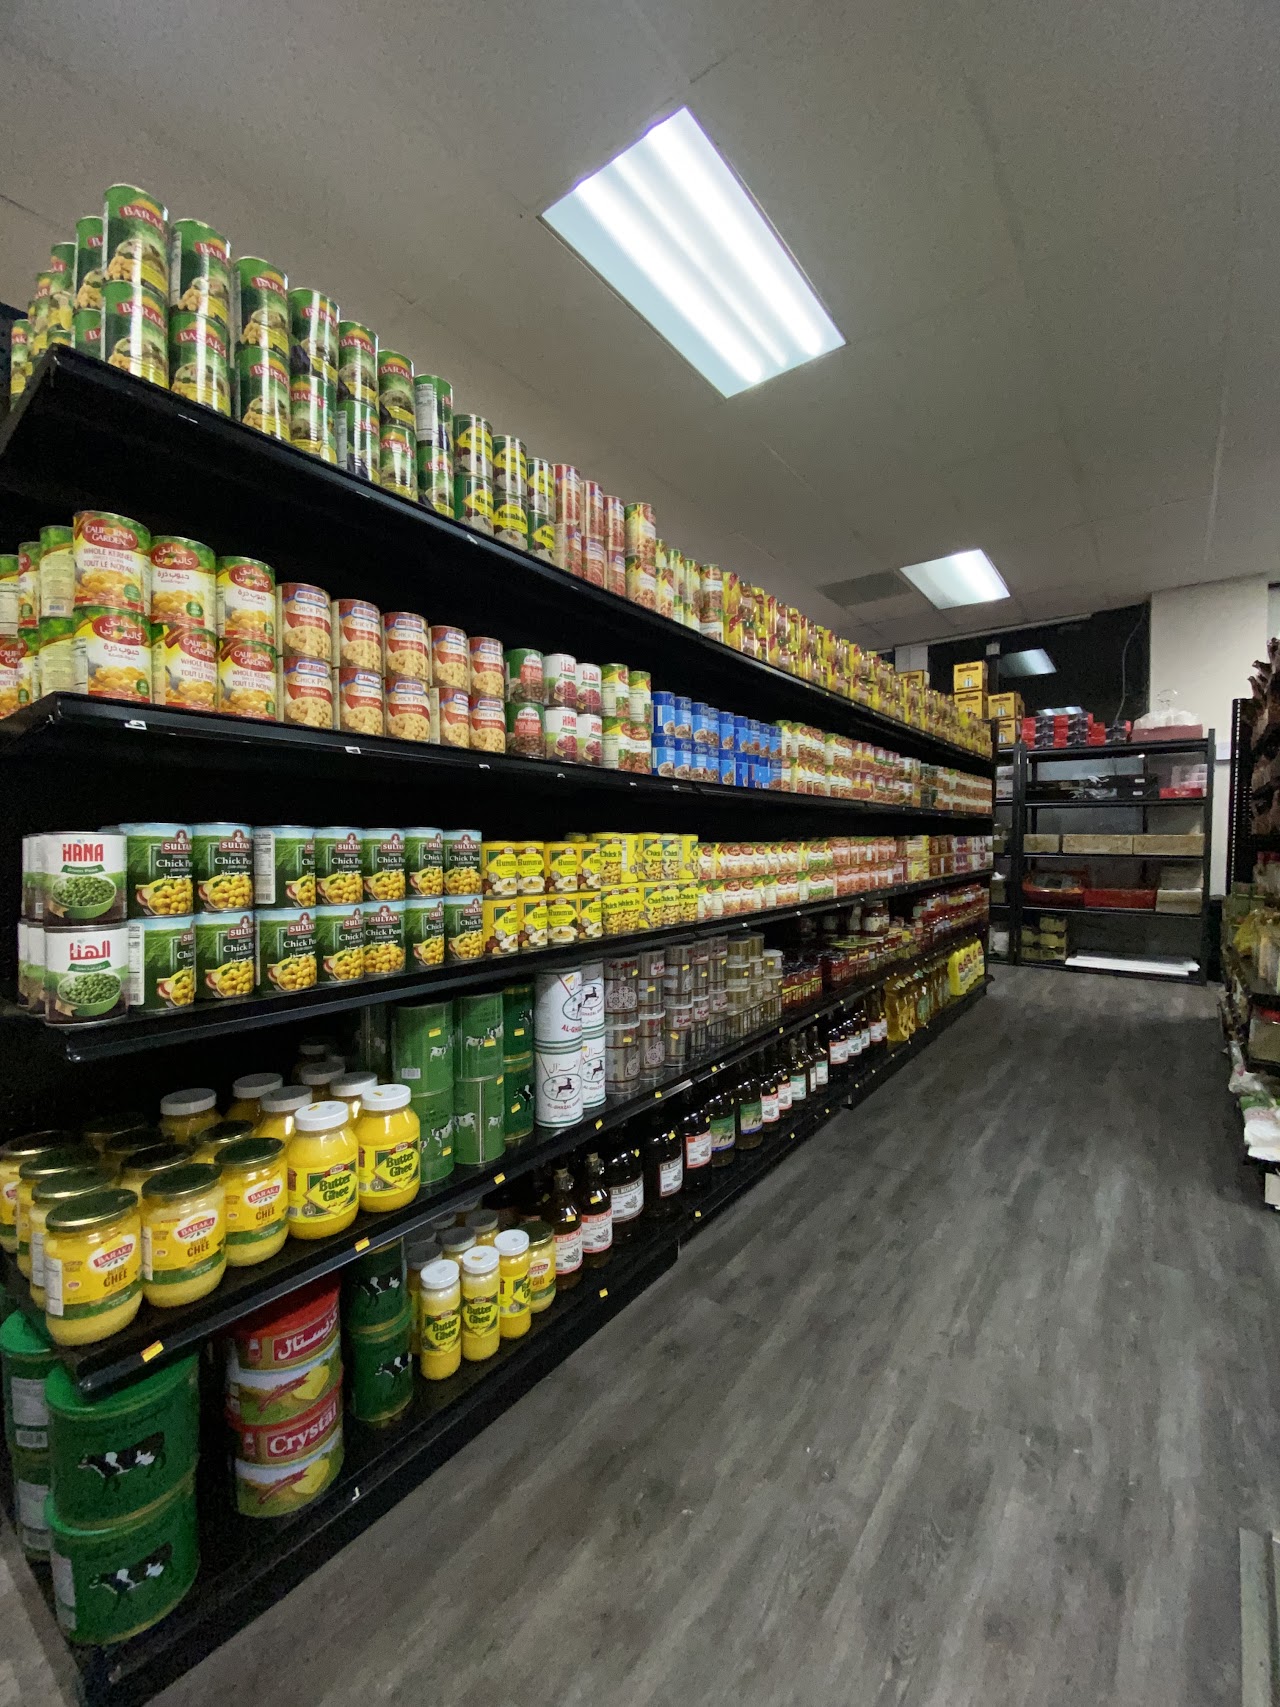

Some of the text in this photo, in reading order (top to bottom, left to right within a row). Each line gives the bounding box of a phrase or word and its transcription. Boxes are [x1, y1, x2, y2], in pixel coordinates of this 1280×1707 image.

[62, 843, 104, 862] HANA
[377, 856, 398, 864] Chick
[156, 860, 183, 868] Chick
[214, 857, 241, 865] Chick
[331, 857, 354, 865] Chick
[339, 934, 360, 942] Chick
[365, 929, 387, 937] Chick
[69, 940, 111, 961] الهنا
[223, 944, 247, 953] Chick
[283, 940, 307, 948] Chick
[386, 1150, 415, 1168] Butter
[389, 1162, 413, 1178] Ghee
[319, 1173, 352, 1192] Butter
[250, 1185, 280, 1202] BARAKA
[322, 1186, 349, 1202] Ghee
[180, 1217, 216, 1237] BARAKA
[187, 1240, 209, 1257] GHEE
[103, 1268, 127, 1287] GHEE
[466, 1304, 493, 1314] Butter
[432, 1316, 458, 1332] Butter
[469, 1313, 490, 1324] Ghee
[435, 1326, 457, 1341] Ghee
[269, 1402, 338, 1455] Crystal
